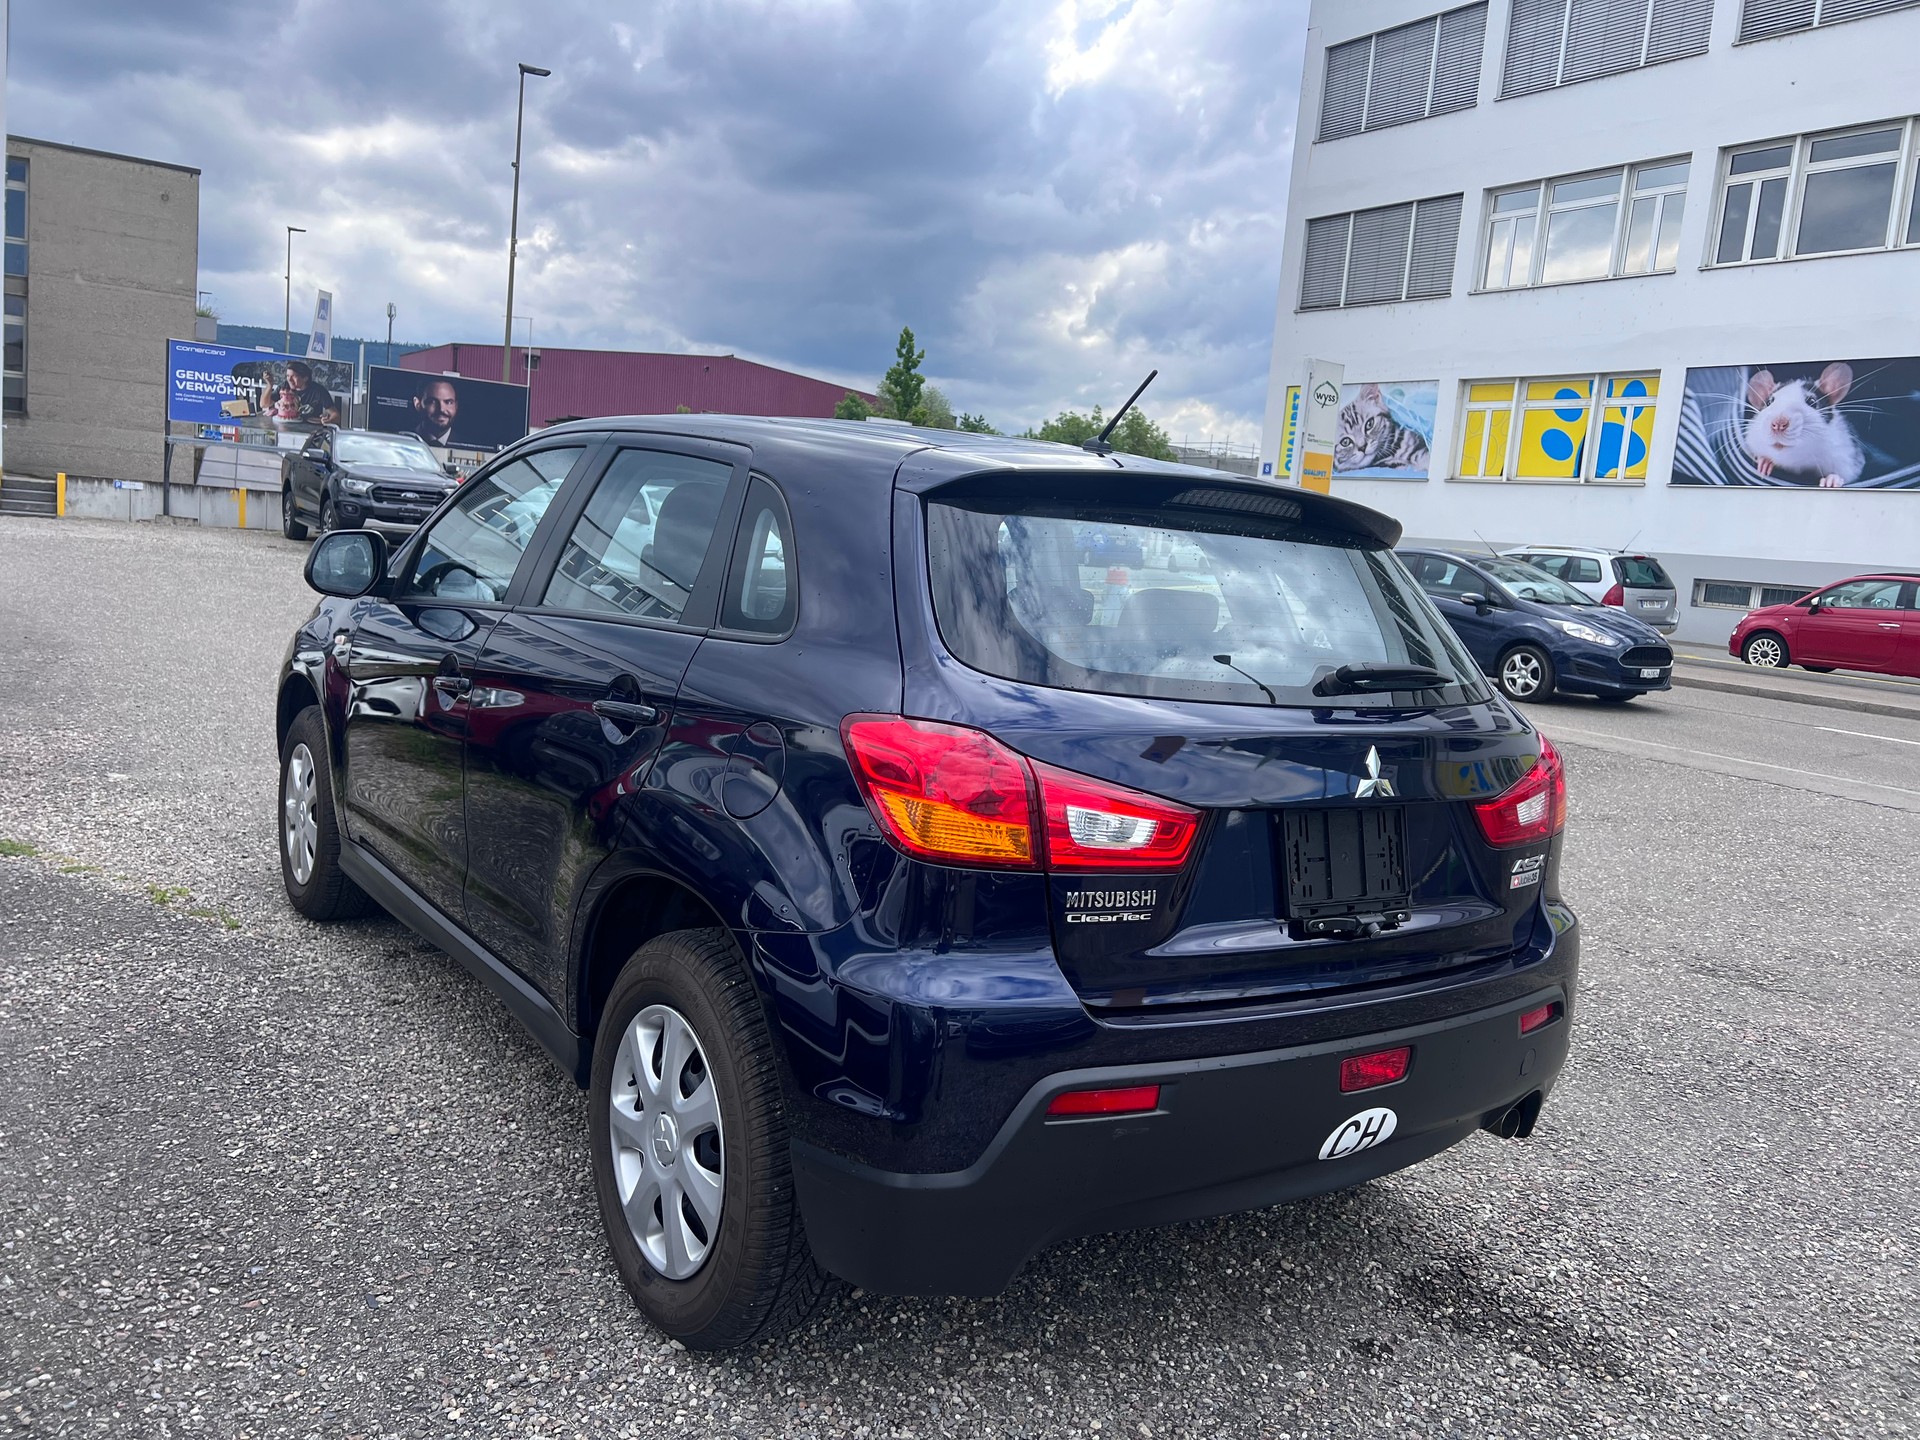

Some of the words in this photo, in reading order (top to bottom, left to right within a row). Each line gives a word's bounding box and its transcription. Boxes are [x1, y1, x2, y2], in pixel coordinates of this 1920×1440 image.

[175, 369, 267, 388] GENUSSVOLL
[175, 380, 257, 398] VERWÖHNT.
[1303, 468, 1327, 478] QUALIPET
[1511, 854, 1546, 873] ASX
[1066, 889, 1157, 908] MITSUBISHI
[1066, 912, 1152, 923] ClearTec
[1326, 1112, 1389, 1159] CH
